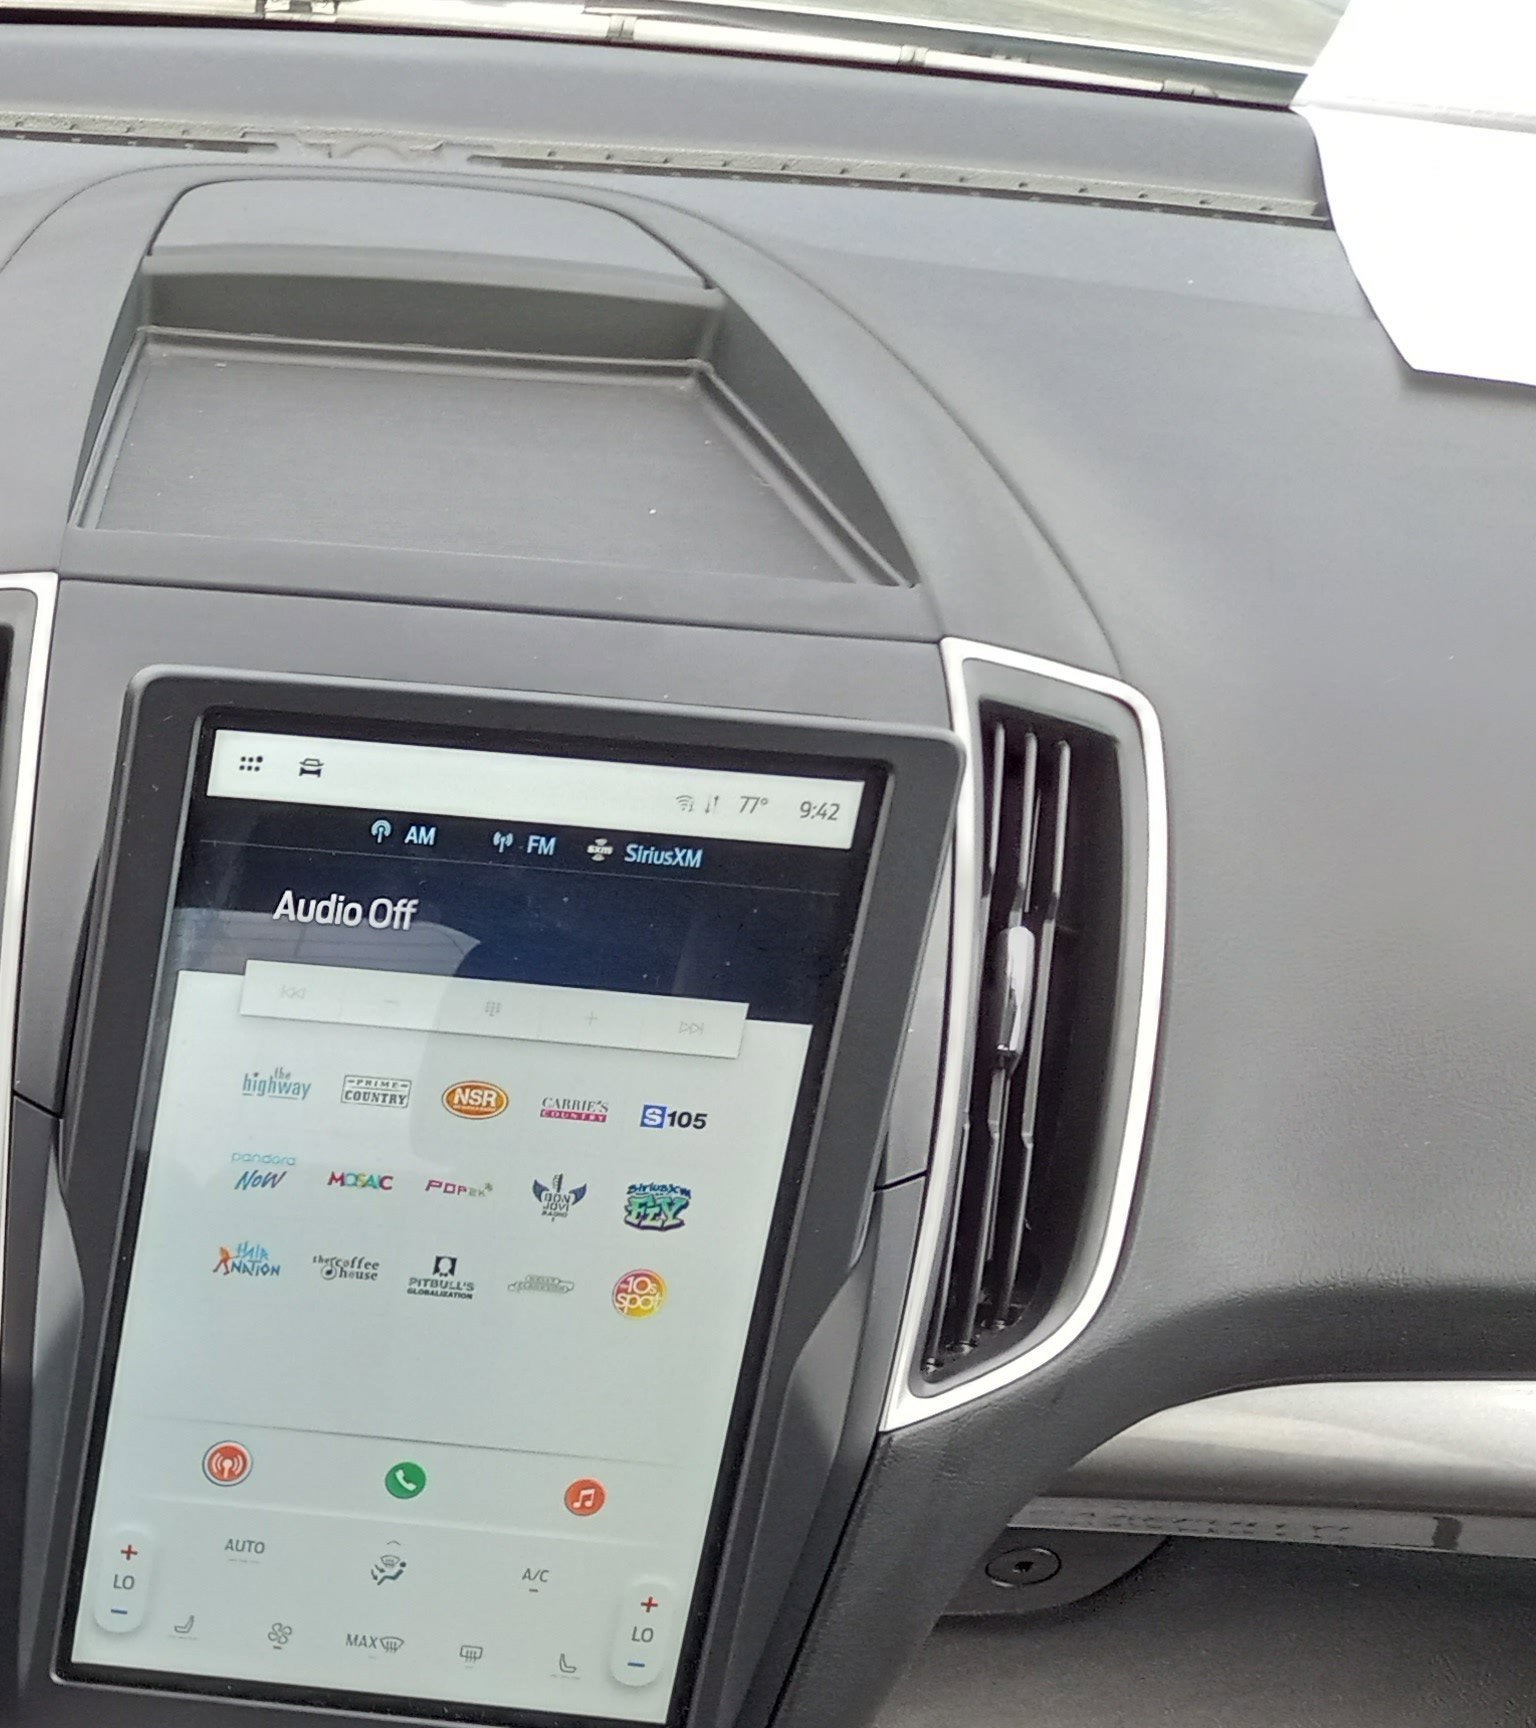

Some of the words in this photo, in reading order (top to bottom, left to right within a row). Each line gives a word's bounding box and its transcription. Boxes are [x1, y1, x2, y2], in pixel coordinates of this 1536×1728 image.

[799, 800, 841, 822] 9:42
[404, 825, 436, 846] AM
[526, 836, 557, 856] FM
[624, 843, 703, 868] SiriusXM
[273, 890, 360, 929] Audio
[369, 898, 417, 931] Off
[274, 1066, 292, 1080] the
[242, 1073, 312, 1100] highway
[356, 1079, 399, 1089] PRIME
[344, 1089, 407, 1106] COUNTRY
[453, 1087, 497, 1107] NSR
[541, 1110, 606, 1122] COUNTRY
[327, 1171, 394, 1191] MOSAIC
[335, 1255, 381, 1272] coffee
[339, 1268, 378, 1281] house
[615, 1291, 665, 1314] spot
[224, 1538, 266, 1555] AUTO
[522, 1568, 550, 1584] A/C
[345, 1633, 379, 1650] MAX
